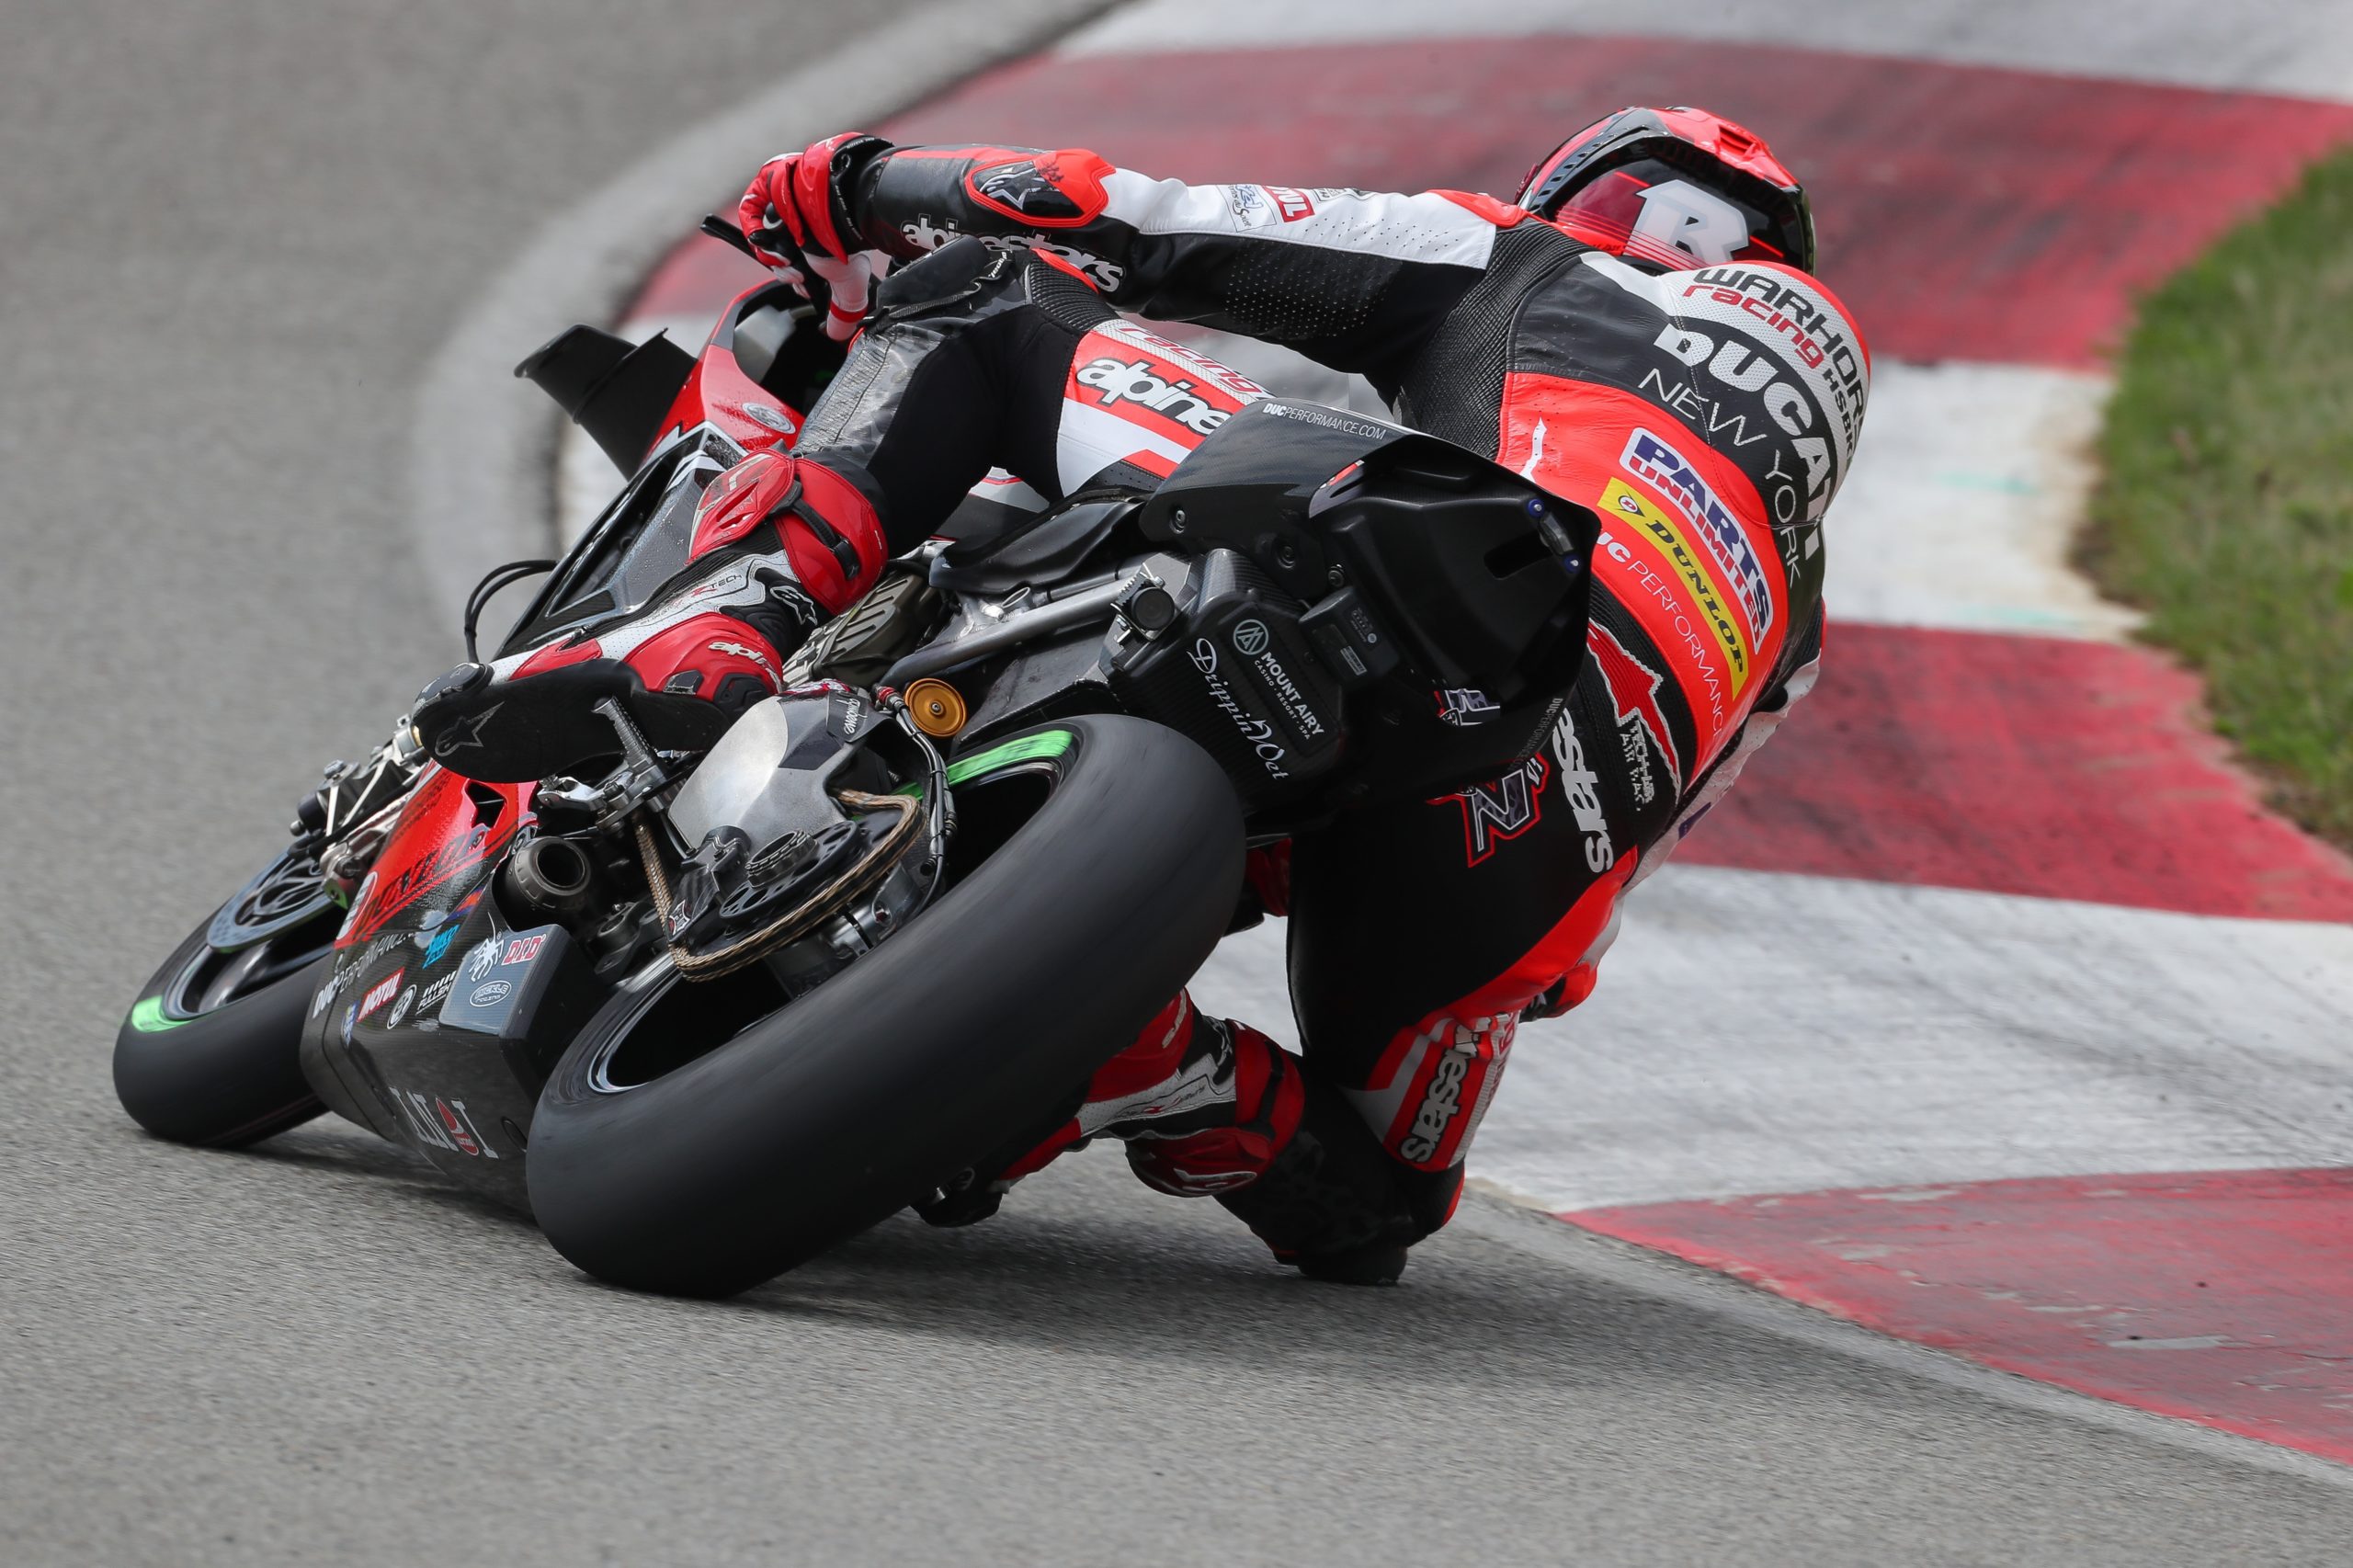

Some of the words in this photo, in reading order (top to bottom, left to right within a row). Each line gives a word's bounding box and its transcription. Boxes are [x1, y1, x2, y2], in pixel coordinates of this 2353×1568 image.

[1263, 403, 1386, 440] DUCPERFORMANCE.COM
[1683, 284, 1825, 369] racing
[1822, 369, 1854, 458] HSBK
[1628, 455, 1762, 647] UNLIMITED
[1633, 435, 1770, 632] PARTS
[1638, 368, 1768, 447] NEW
[1764, 449, 1802, 588] YORK
[1645, 519, 1745, 673] DUNLOP
[1255, 660, 1275, 687] CASINO
[1277, 692, 1297, 719] RESORT
[1299, 725, 1311, 740] SPA
[1261, 652, 1302, 701] MOUNT
[1294, 704, 1324, 734] AIRY
